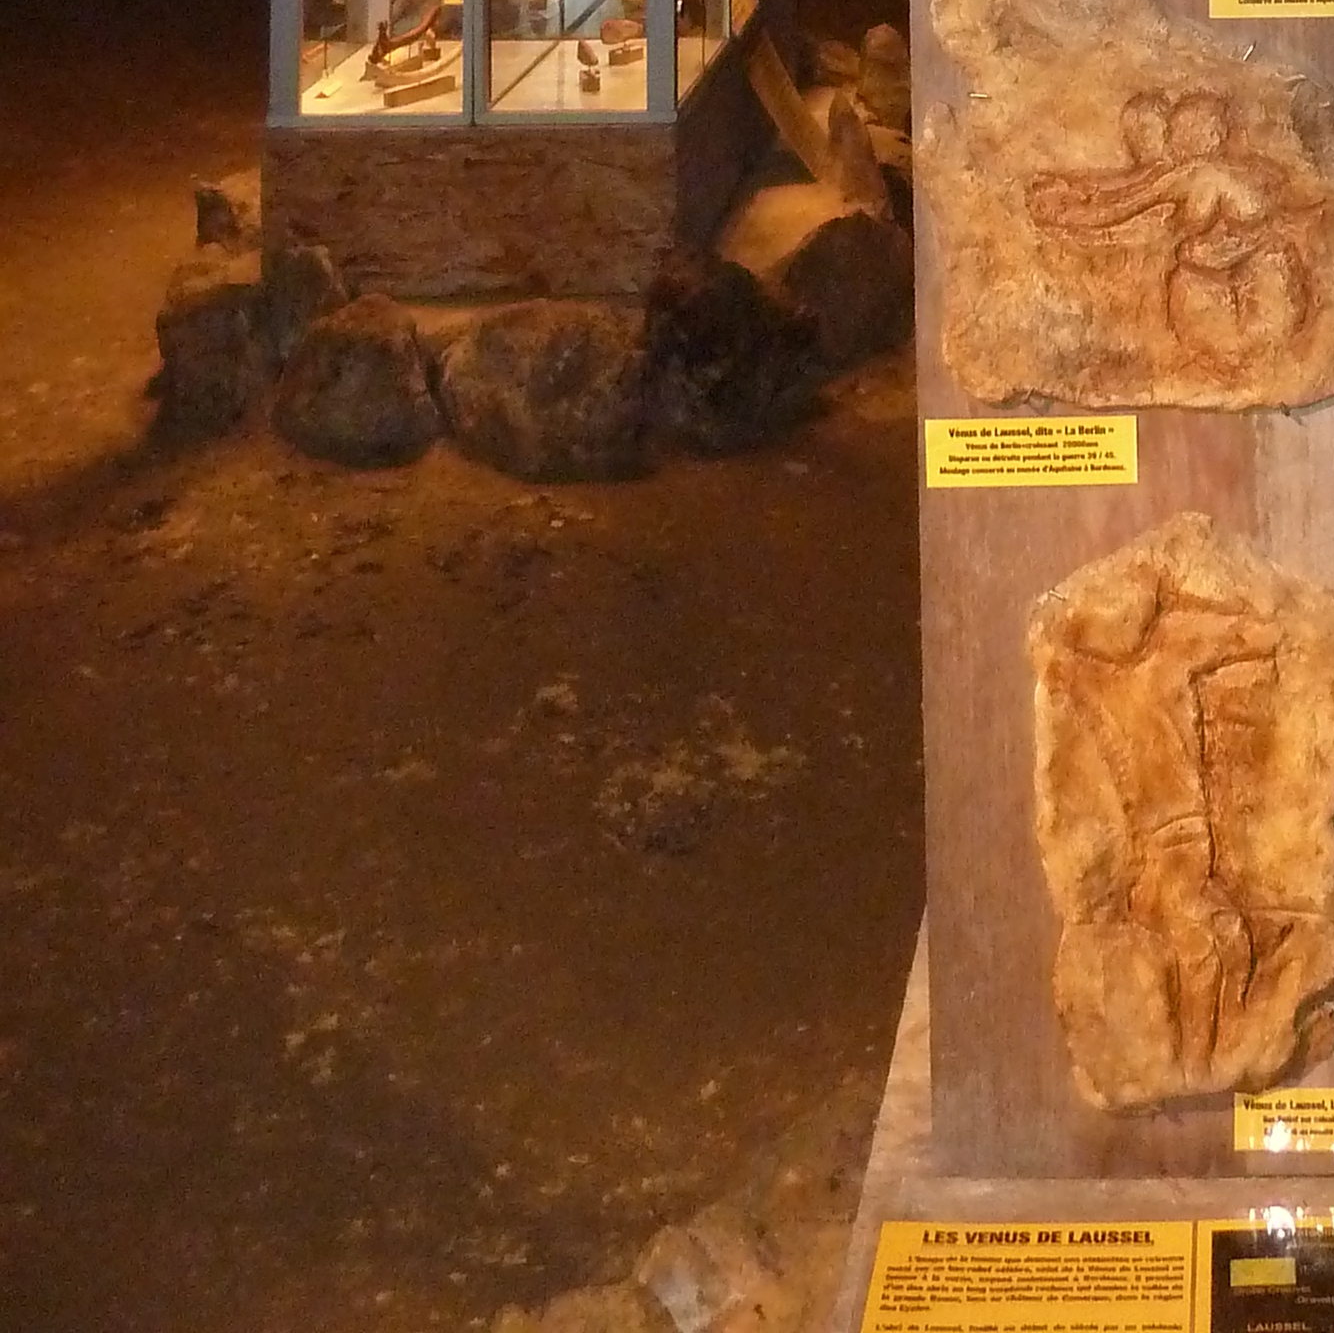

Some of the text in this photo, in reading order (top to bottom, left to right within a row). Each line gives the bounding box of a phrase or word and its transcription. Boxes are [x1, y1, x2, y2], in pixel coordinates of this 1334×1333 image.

[949, 428, 977, 438] Vénus
[980, 428, 991, 437] de
[995, 427, 1032, 437] Laussel,
[1035, 427, 1053, 436] dite
[1065, 426, 1076, 435] La
[1078, 426, 1106, 435] Berlin
[1023, 454, 1051, 462] pendant
[940, 467, 970, 475] Moulage
[1243, 1099, 1272, 1110] Vénus
[1275, 1100, 1286, 1110] de
[1290, 1100, 1328, 1111] Laussel,
[923, 1230, 1154, 1246] LES VENUS DE LAUSSEL
